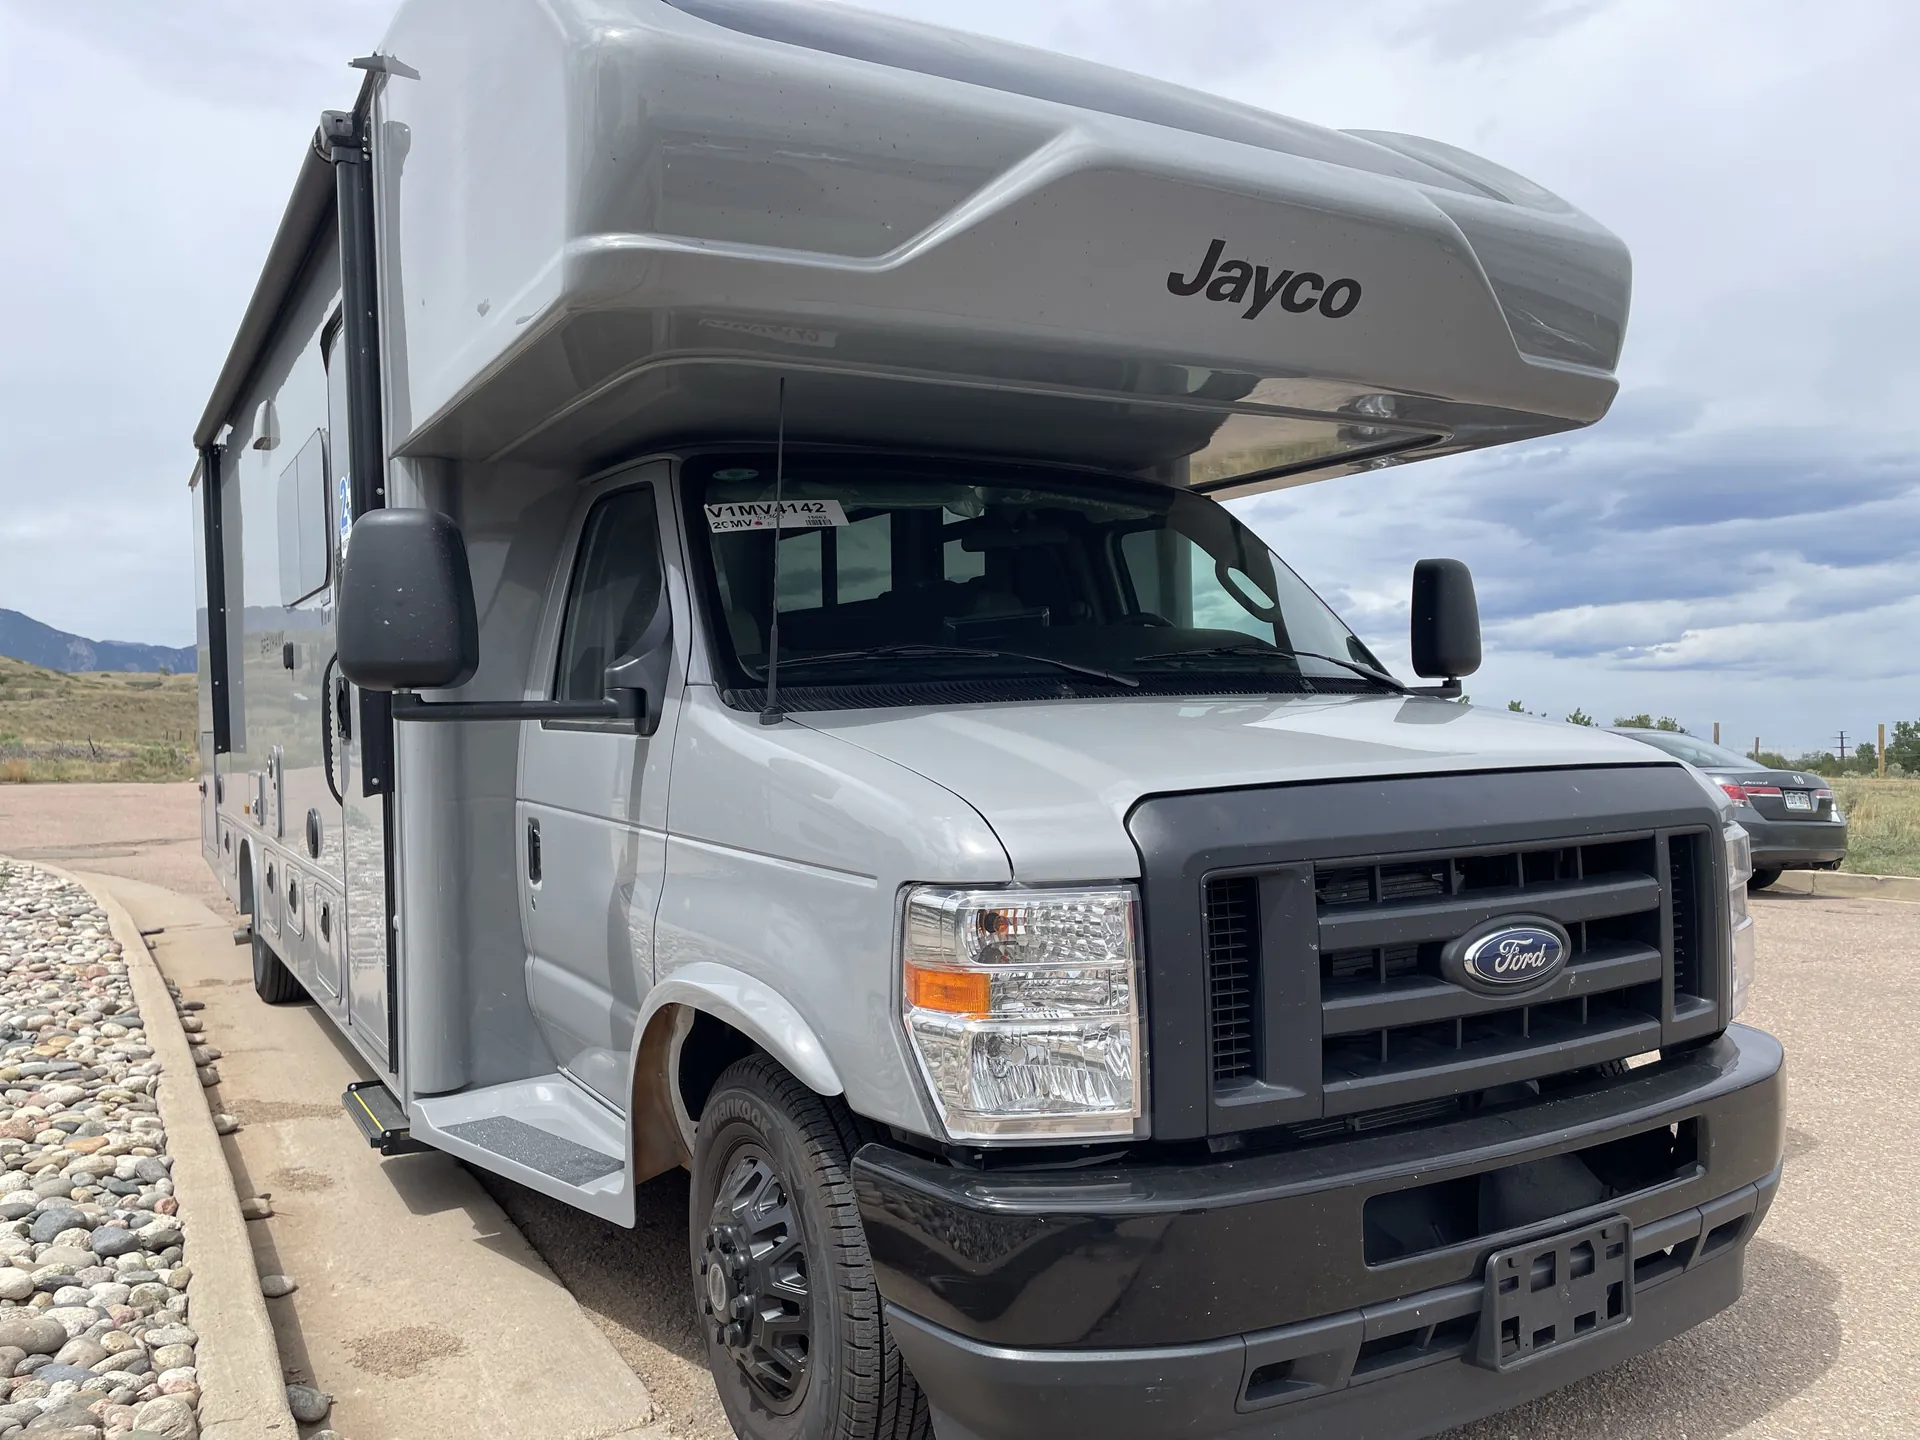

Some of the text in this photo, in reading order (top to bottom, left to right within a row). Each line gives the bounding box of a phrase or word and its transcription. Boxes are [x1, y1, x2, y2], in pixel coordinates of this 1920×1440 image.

[1167, 238, 1362, 320] Jayco
[707, 502, 827, 518] V1MV4142
[1494, 938, 1547, 973] Ford
